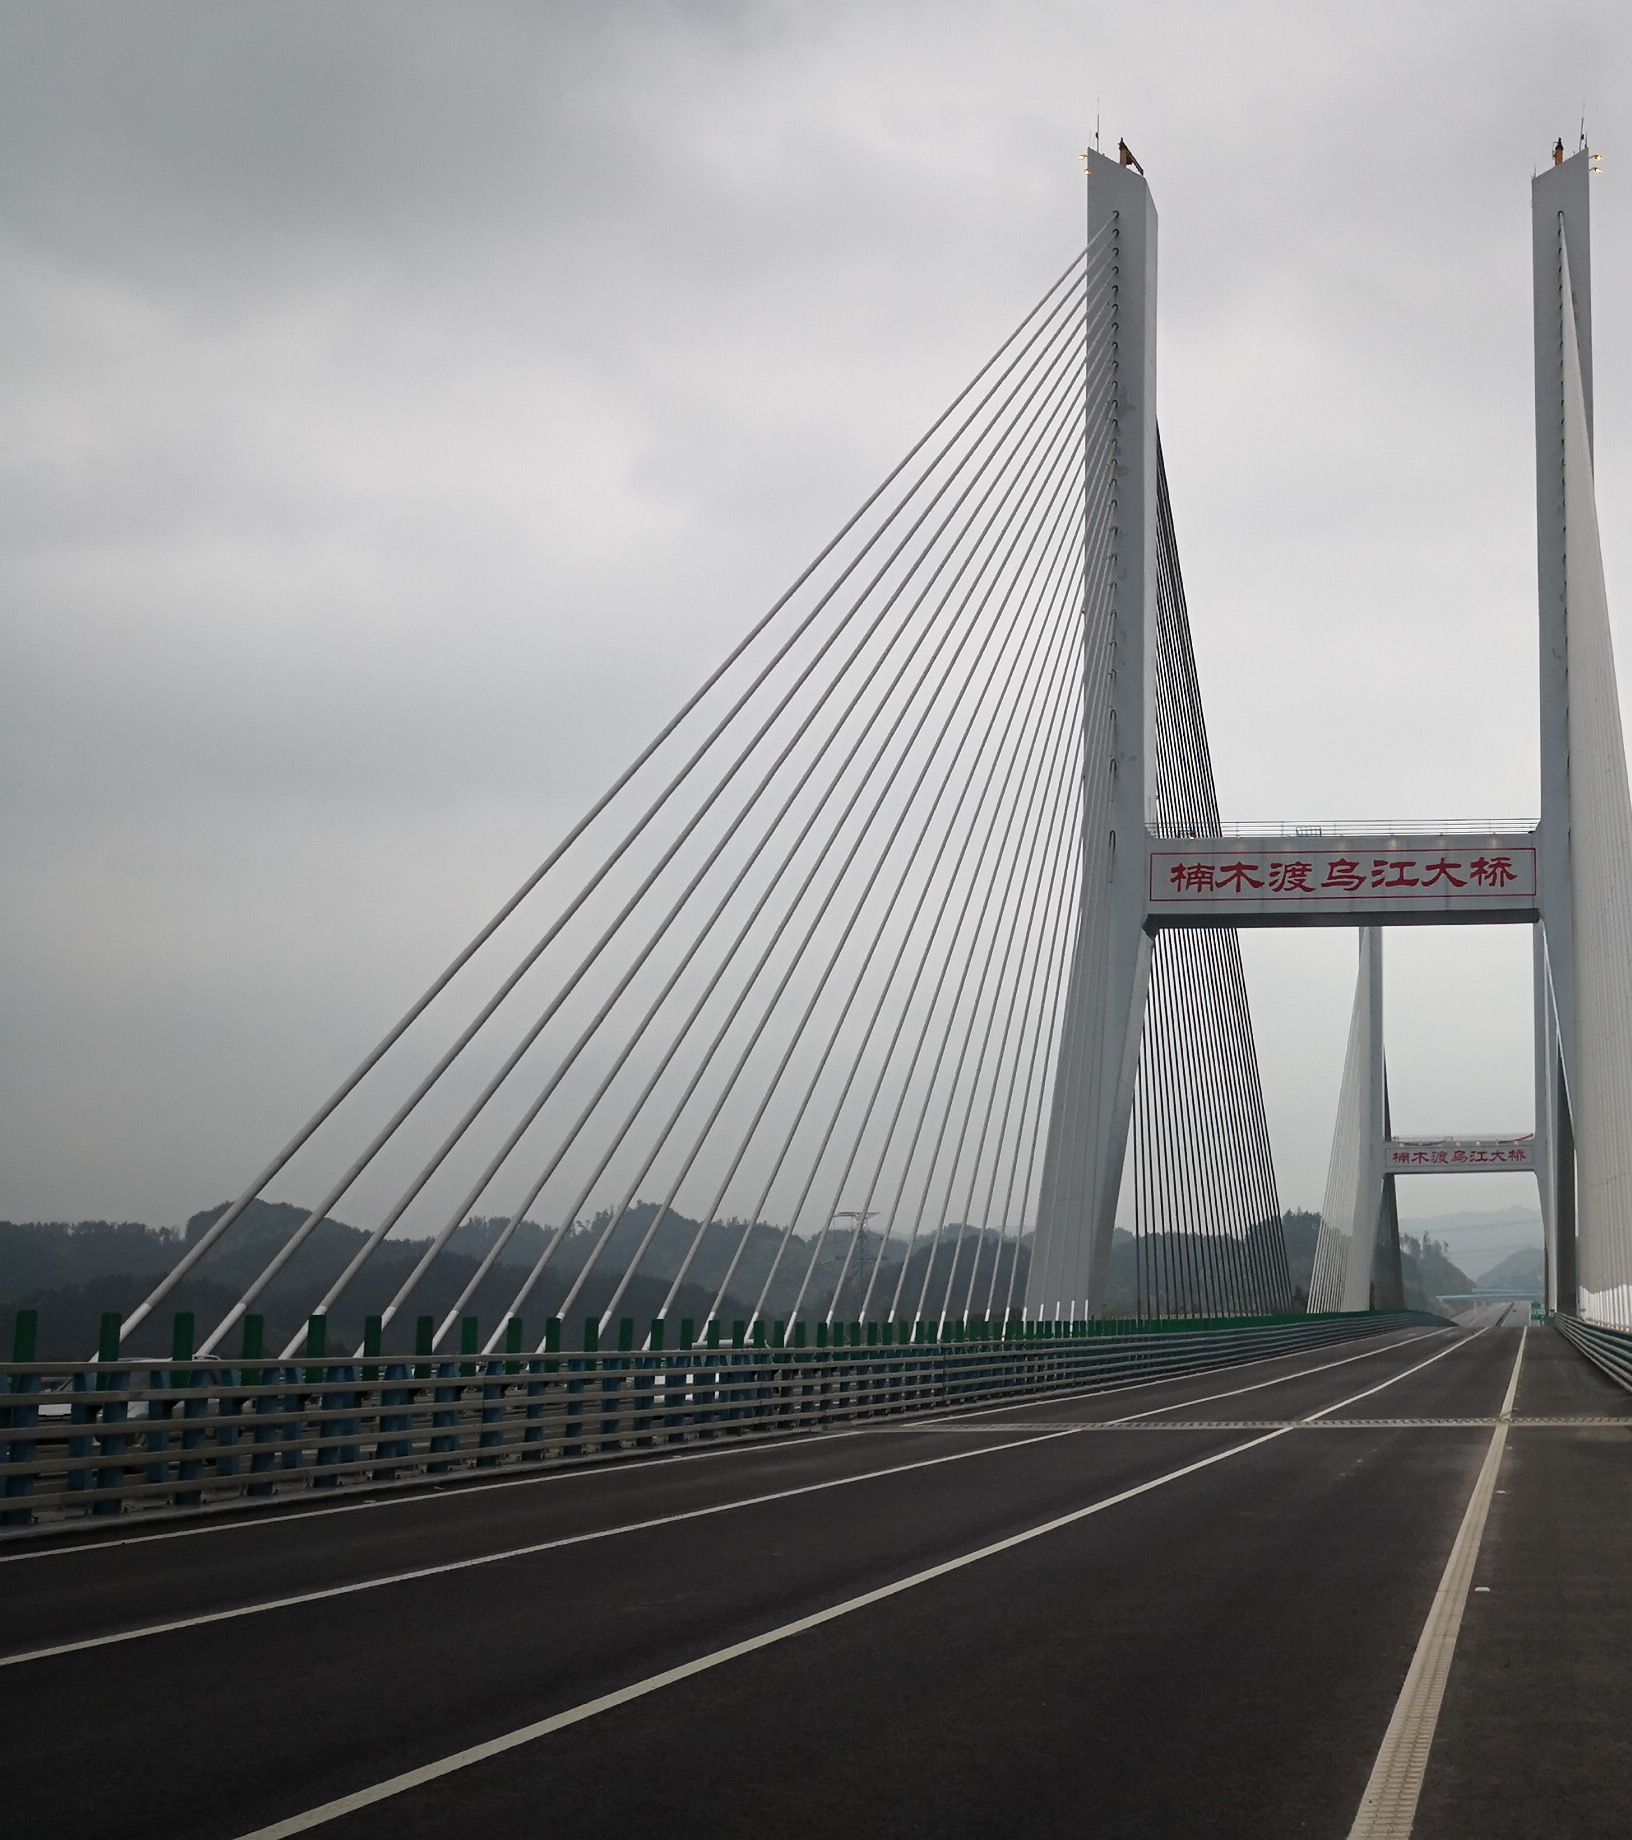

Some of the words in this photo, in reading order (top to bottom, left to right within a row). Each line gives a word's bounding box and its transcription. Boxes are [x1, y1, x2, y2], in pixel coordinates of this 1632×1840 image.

[1170, 856, 1518, 893] 楠木渡乌江大桥
